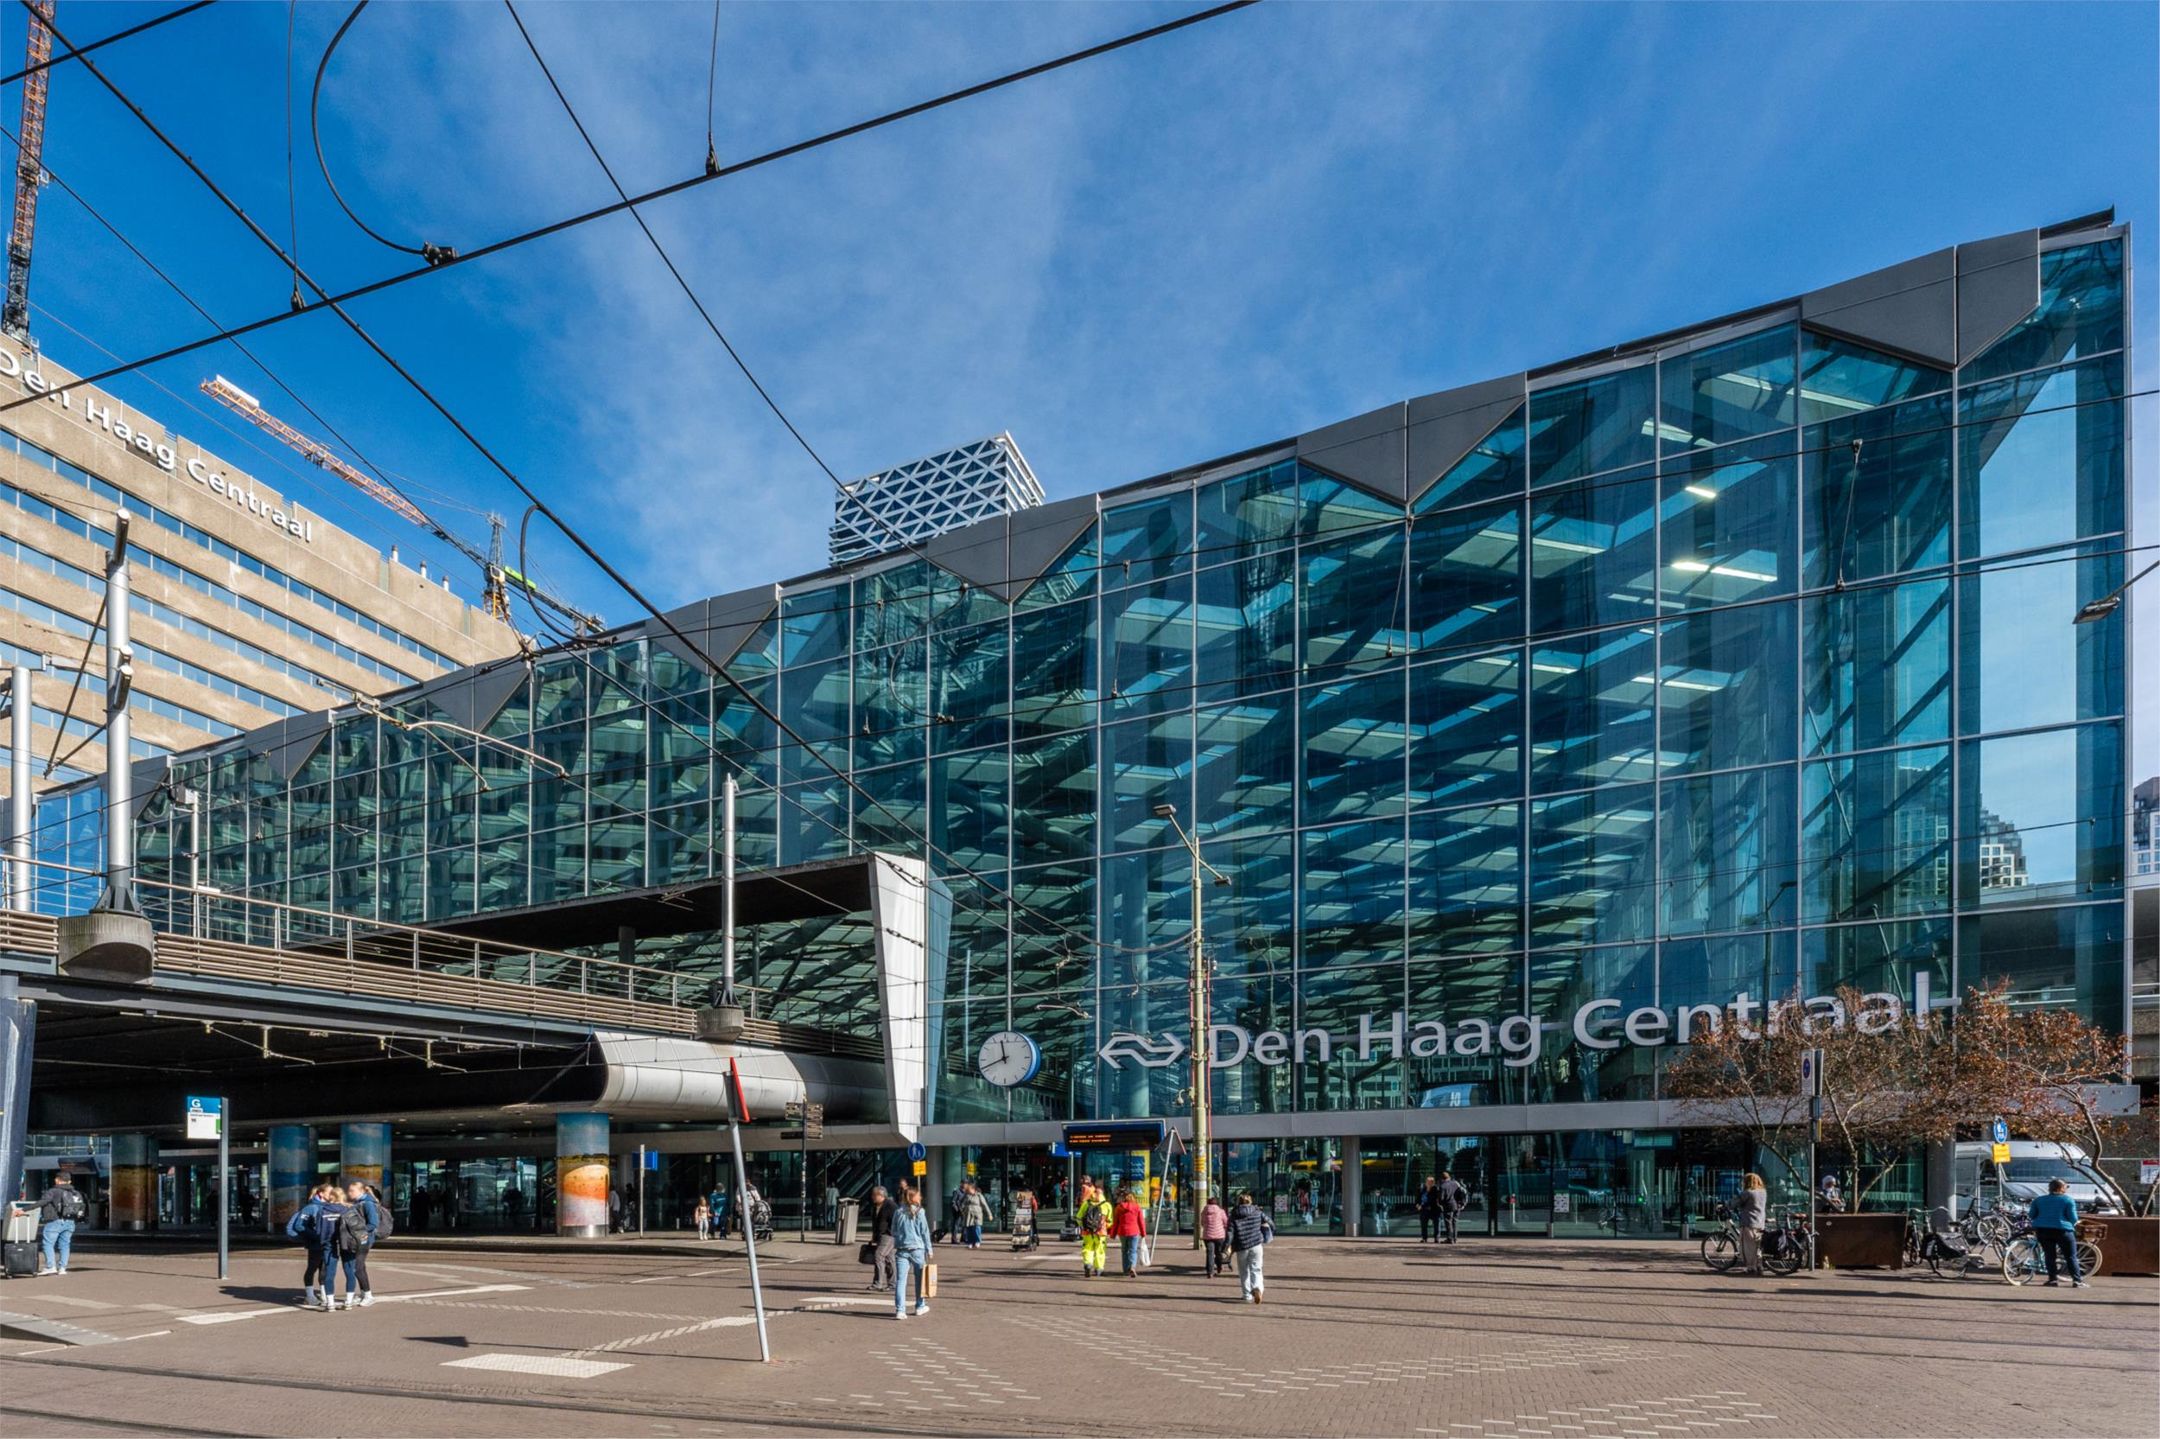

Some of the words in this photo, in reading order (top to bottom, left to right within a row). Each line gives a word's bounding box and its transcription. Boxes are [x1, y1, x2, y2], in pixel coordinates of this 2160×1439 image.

[0, 348, 70, 407] Den
[86, 397, 176, 470] Haag
[187, 458, 312, 542] Centraal
[1208, 1025, 1330, 1068] Den
[1359, 1012, 1541, 1066] Haag
[1572, 972, 1929, 1048] Centraal
[191, 1098, 201, 1108] G
